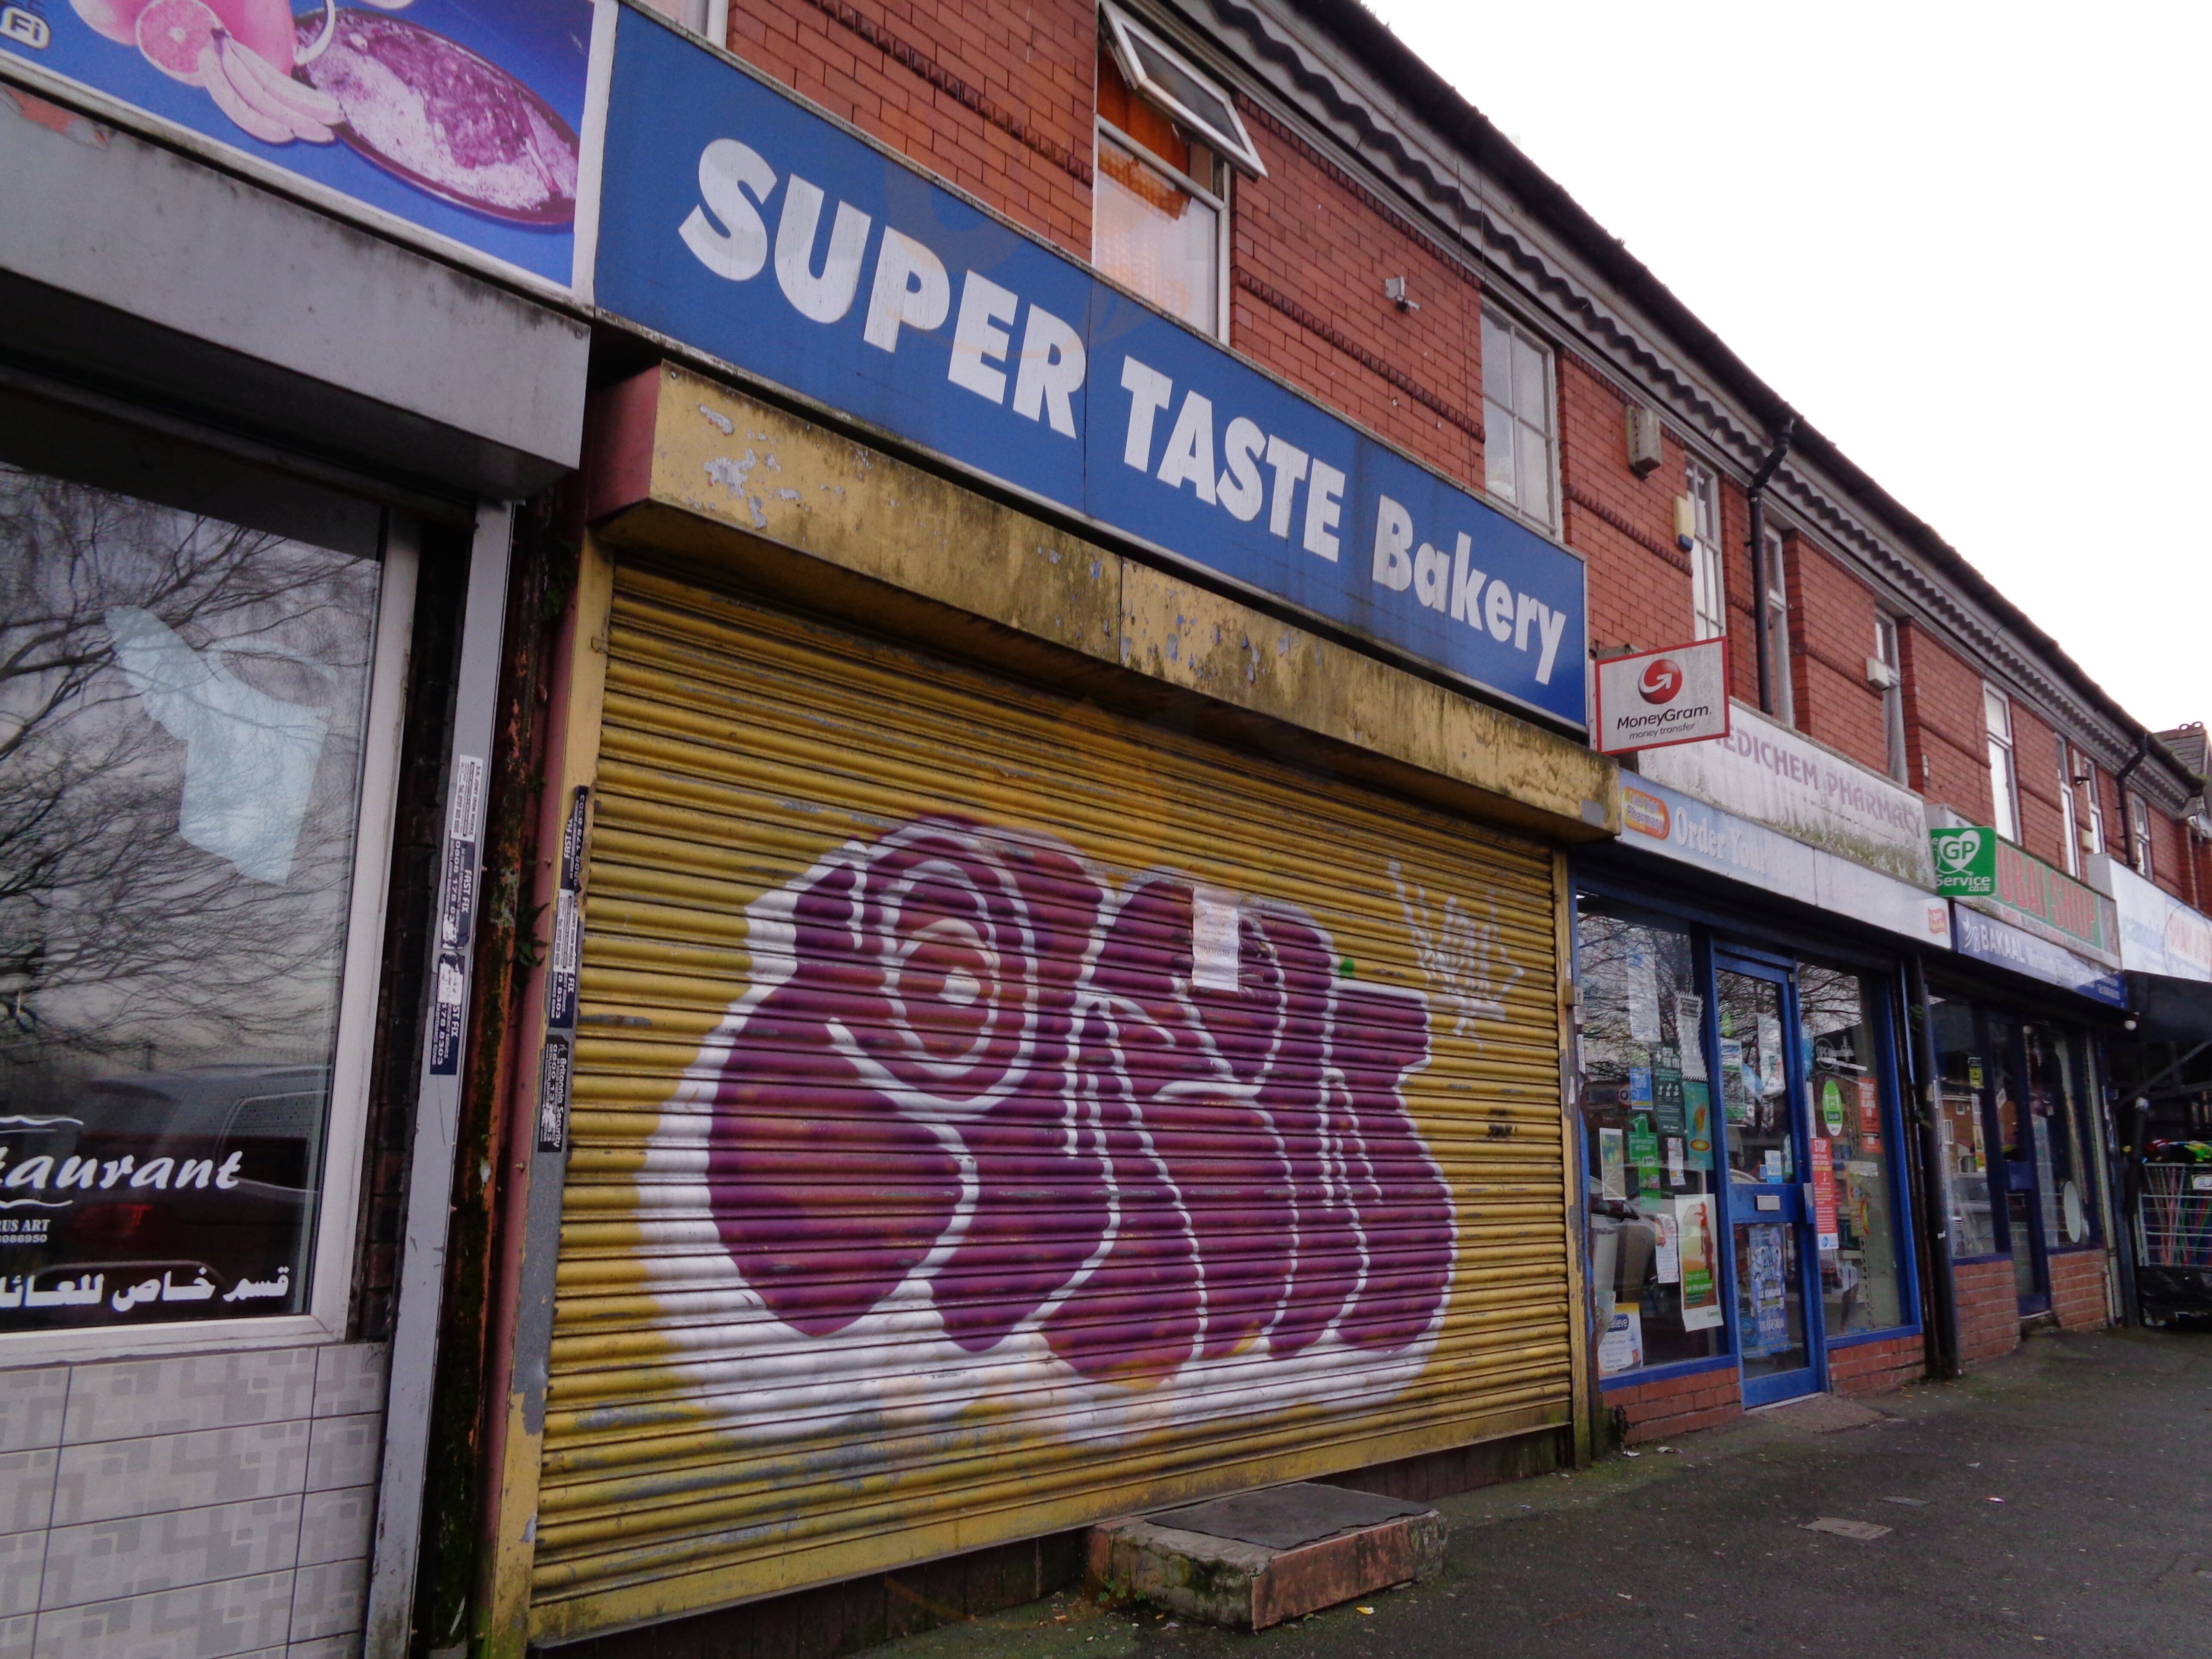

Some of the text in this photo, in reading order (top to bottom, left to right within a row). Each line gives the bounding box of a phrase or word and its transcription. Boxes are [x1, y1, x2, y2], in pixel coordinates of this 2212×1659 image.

[678, 138, 1567, 685] SUPER TASTE Bakery
[1617, 704, 1709, 730] MoneyGram
[1629, 723, 1695, 740] money transfer
[1715, 726, 1922, 838] EDICHEM PHARMACY
[1627, 804, 1664, 834] Pharmacy
[1674, 805, 1726, 860] Order
[564, 834, 572, 859] FAST
[1943, 841, 1976, 860] GP
[461, 869, 472, 913] FAST FIX
[1936, 874, 1991, 887] Service
[1994, 841, 2048, 919] UBAI
[2050, 870, 2096, 941] SHOP
[1981, 924, 2026, 963] BAKAAL
[451, 1021, 459, 1038] FIX
[553, 1057, 567, 1148] Britannia Security
[0, 1234, 48, 1243] 086950
[21, 1219, 51, 1232] ART
[112, 1267, 217, 1312] خاص
[223, 1266, 290, 1302] قسم
[1610, 1316, 1629, 1329] alieve
